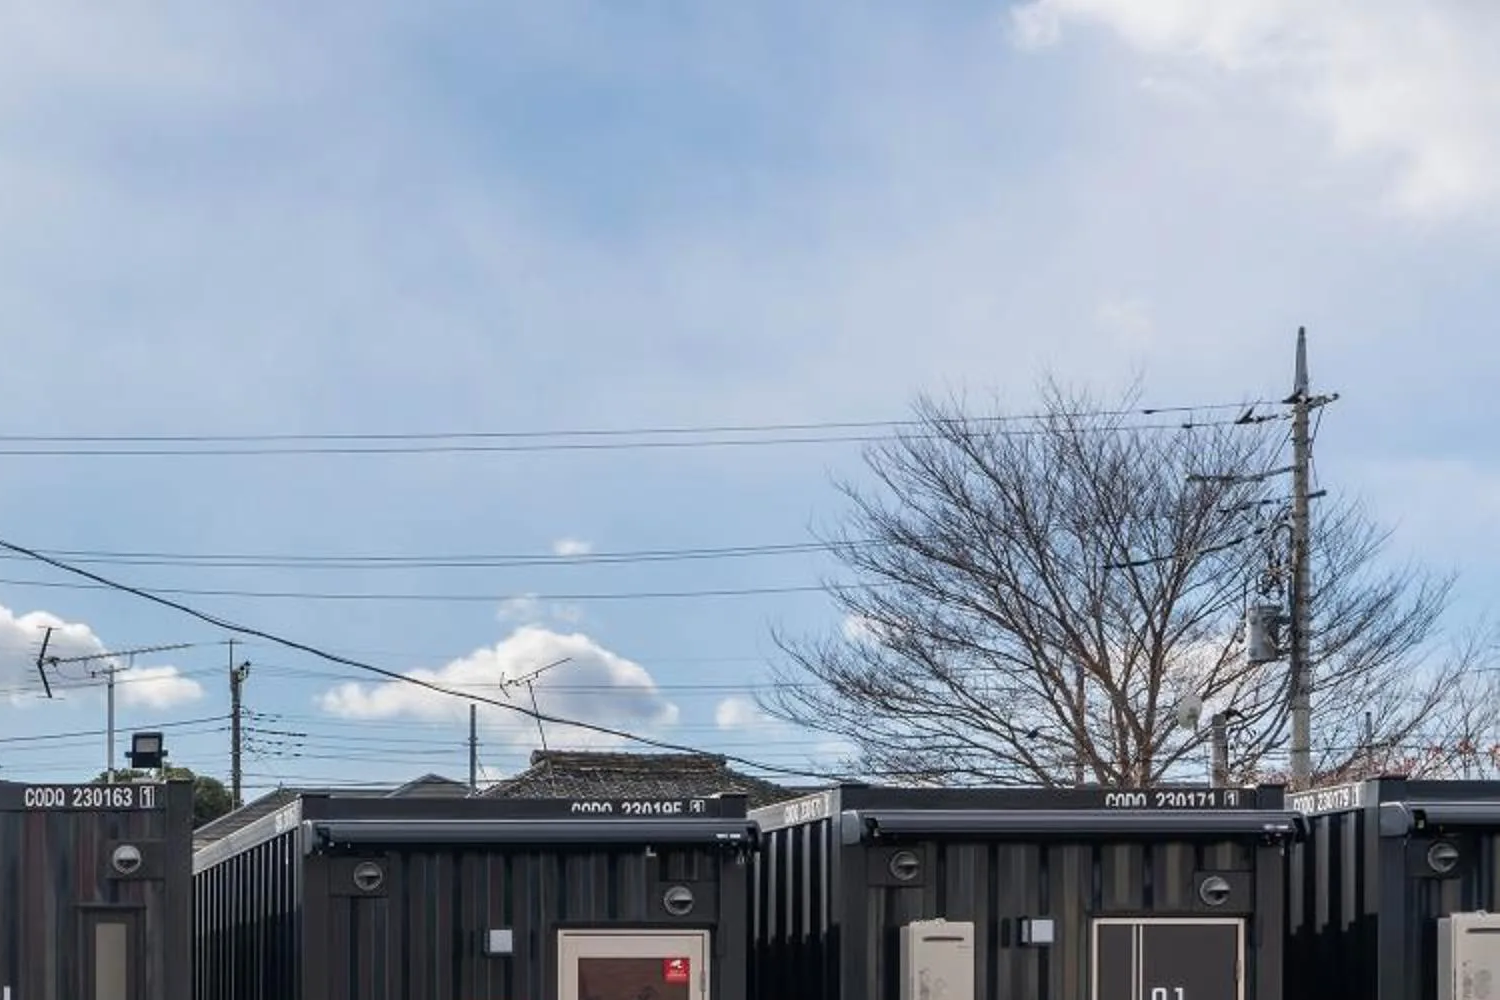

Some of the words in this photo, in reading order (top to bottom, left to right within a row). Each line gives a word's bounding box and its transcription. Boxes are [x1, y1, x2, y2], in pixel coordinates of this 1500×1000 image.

[25, 787, 65, 807] CODQ
[73, 787, 133, 807] 230163
[1156, 792, 1216, 807] 230171
